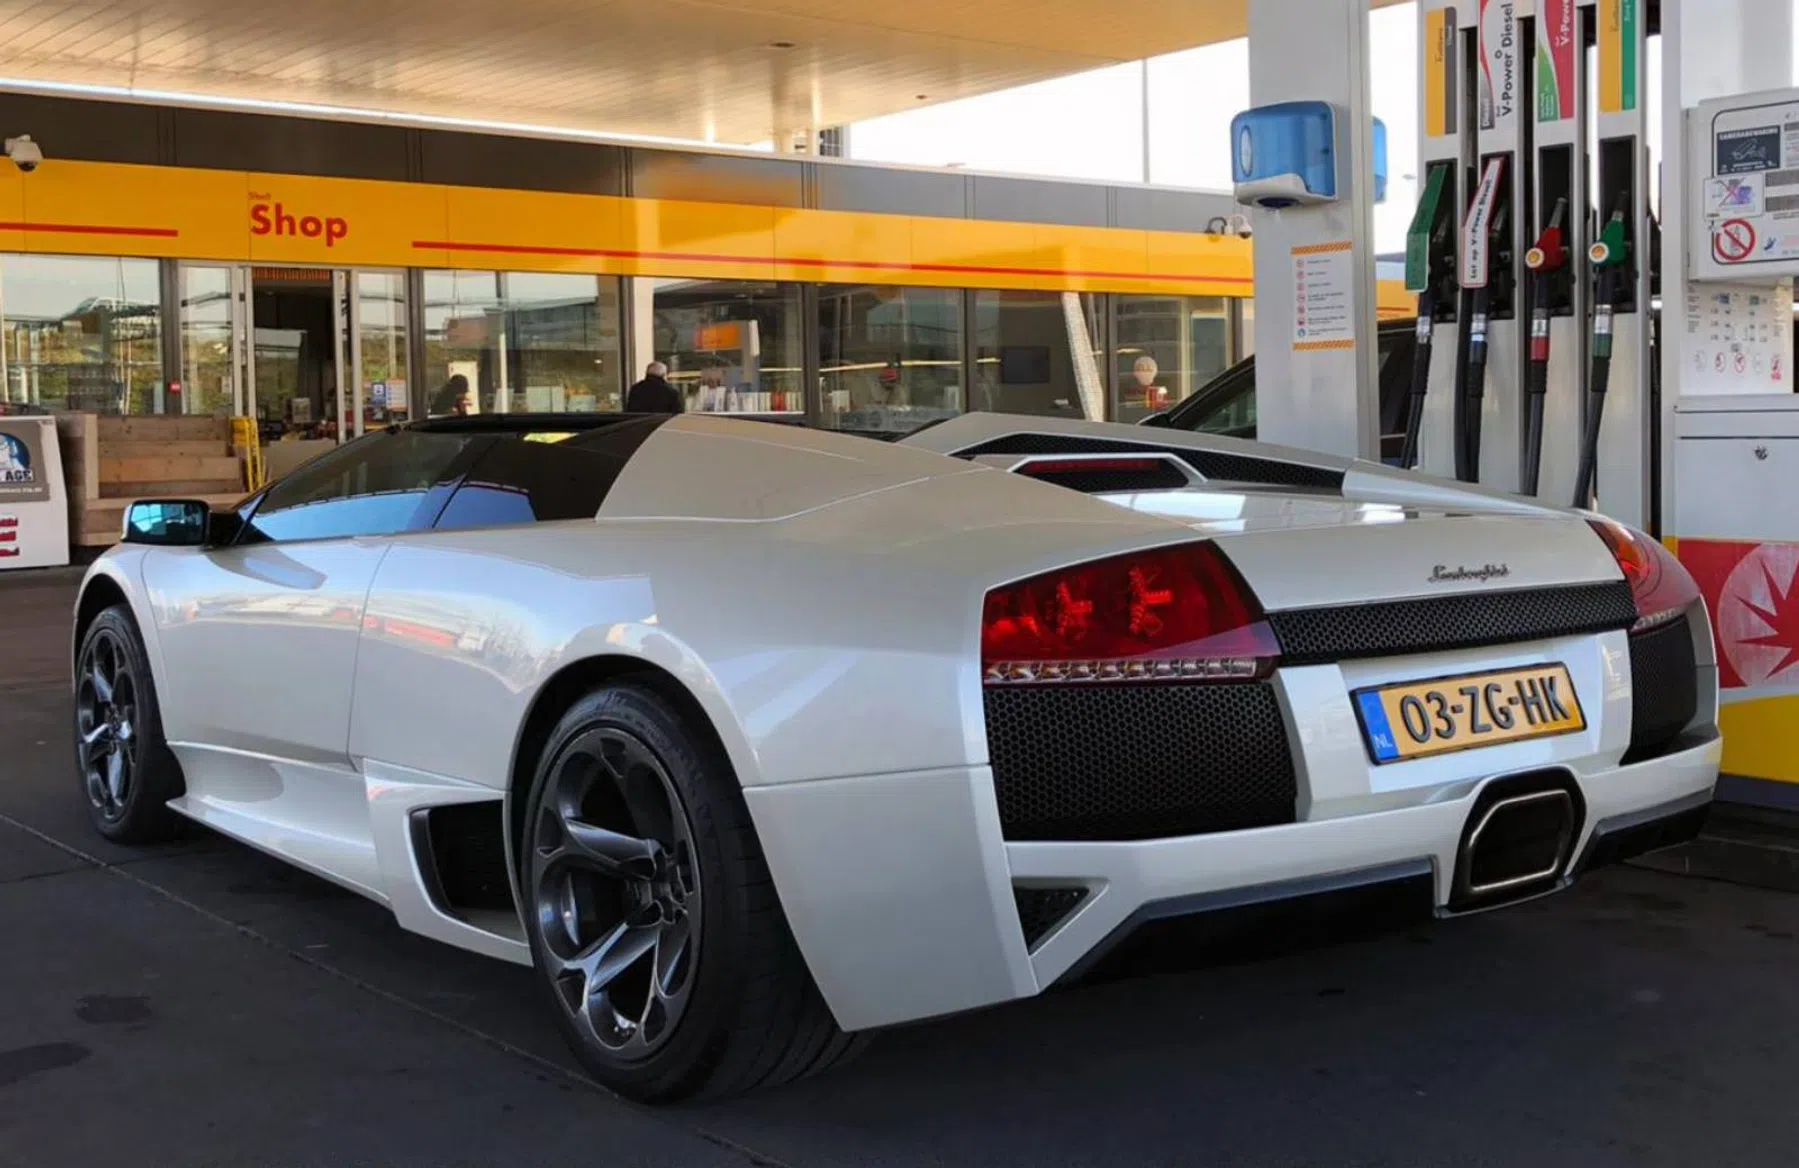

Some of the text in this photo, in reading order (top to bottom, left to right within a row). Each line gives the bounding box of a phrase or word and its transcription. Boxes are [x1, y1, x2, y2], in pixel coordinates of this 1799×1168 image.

[1501, 2, 1513, 116] V-Power Diesel
[250, 201, 348, 248] Shop
[1400, 675, 1571, 744] 03-ZG-HK
[1373, 735, 1393, 749] NL
